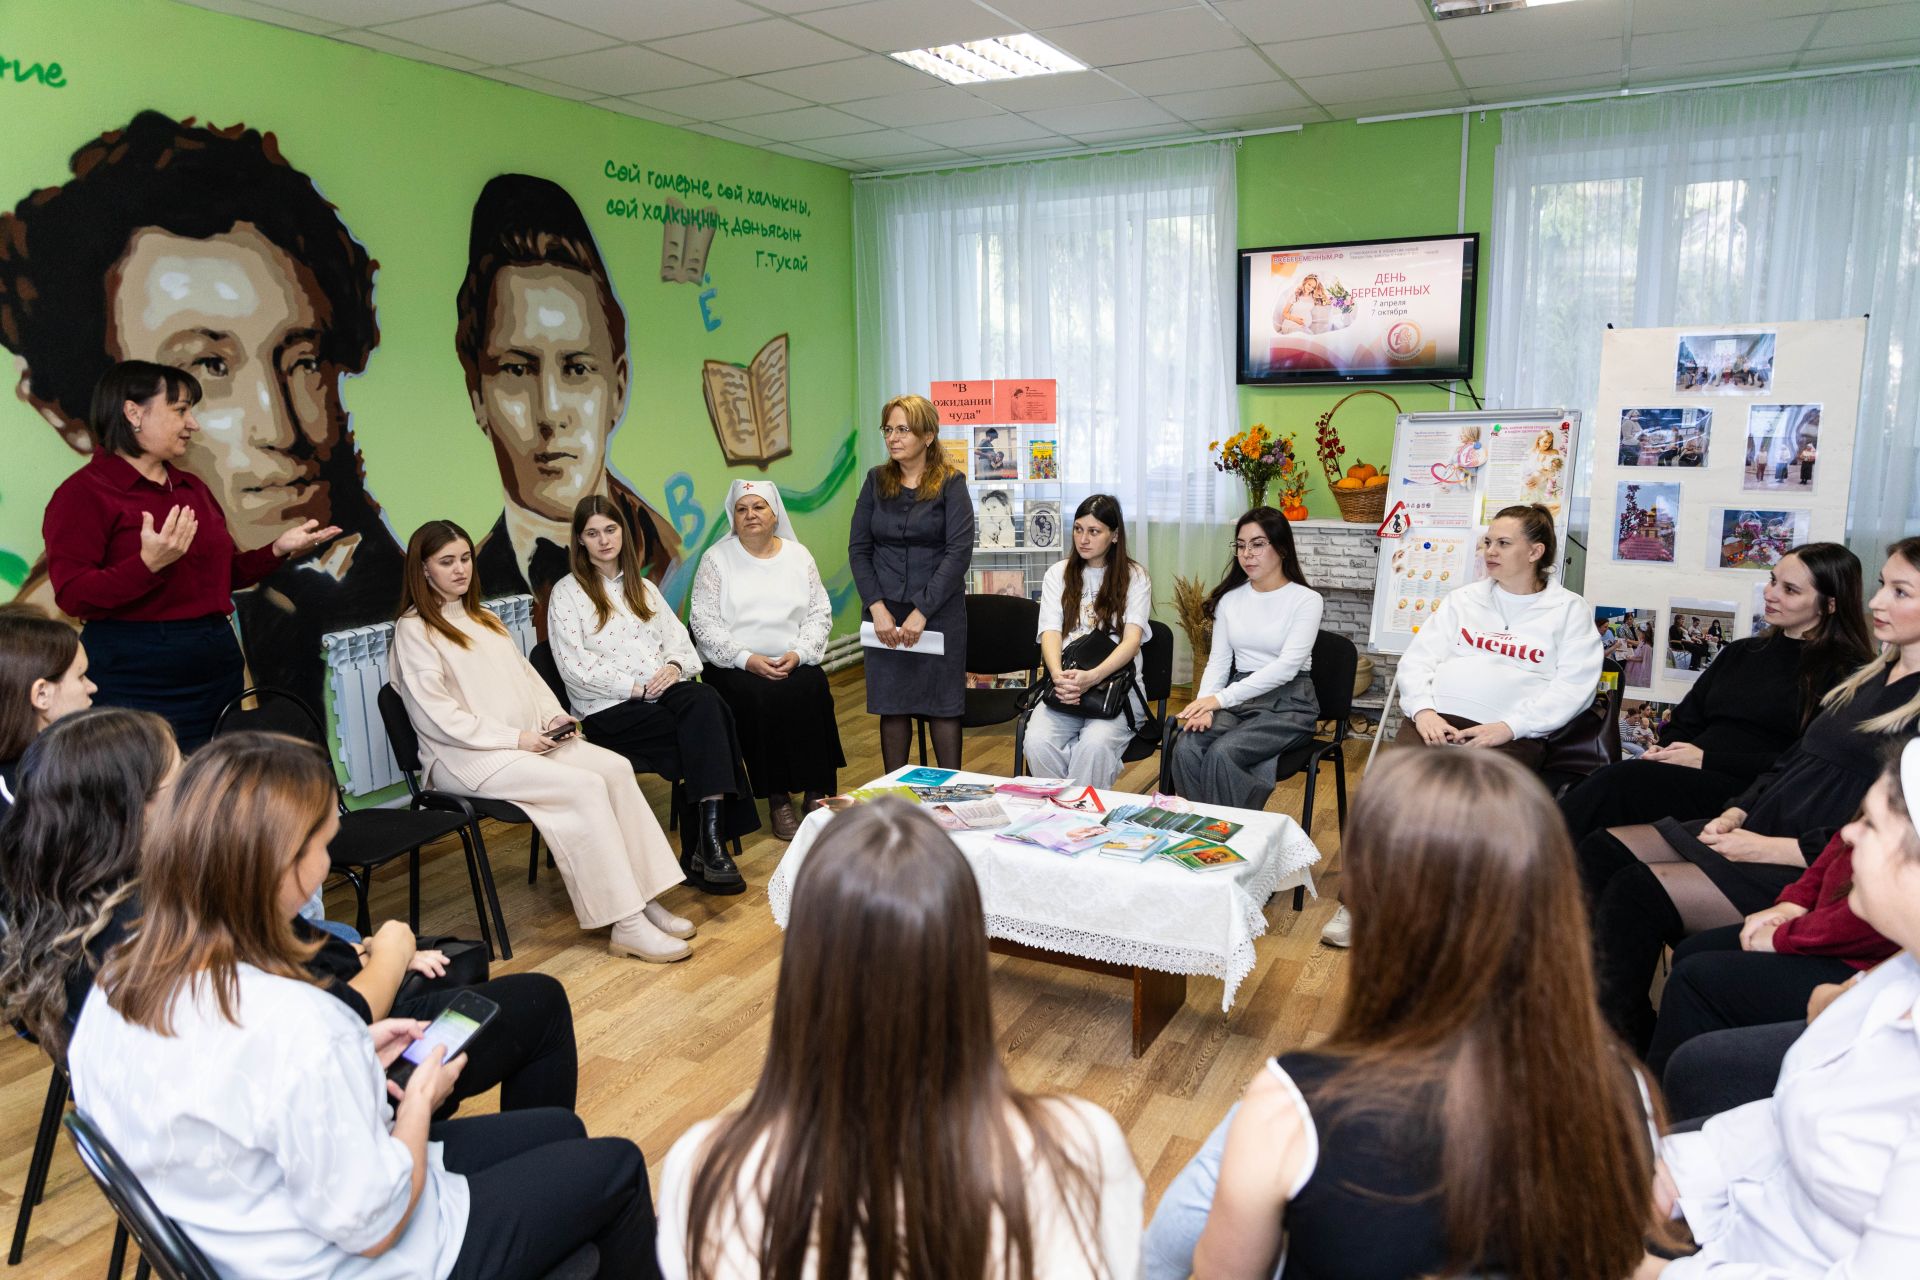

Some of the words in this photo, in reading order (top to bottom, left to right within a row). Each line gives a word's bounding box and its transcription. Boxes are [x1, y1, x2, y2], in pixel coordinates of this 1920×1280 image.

[1375, 272, 1406, 285] ДЕНЬ
[1351, 284, 1431, 299] БЕРЕМЕННЫХ
[1380, 300, 1406, 308] апреля
[1378, 308, 1408, 317] октября
[952, 383, 967, 393] "В
[933, 397, 992, 408] ожидании
[949, 409, 981, 422] чуда"
[1457, 627, 1544, 664] Niente
